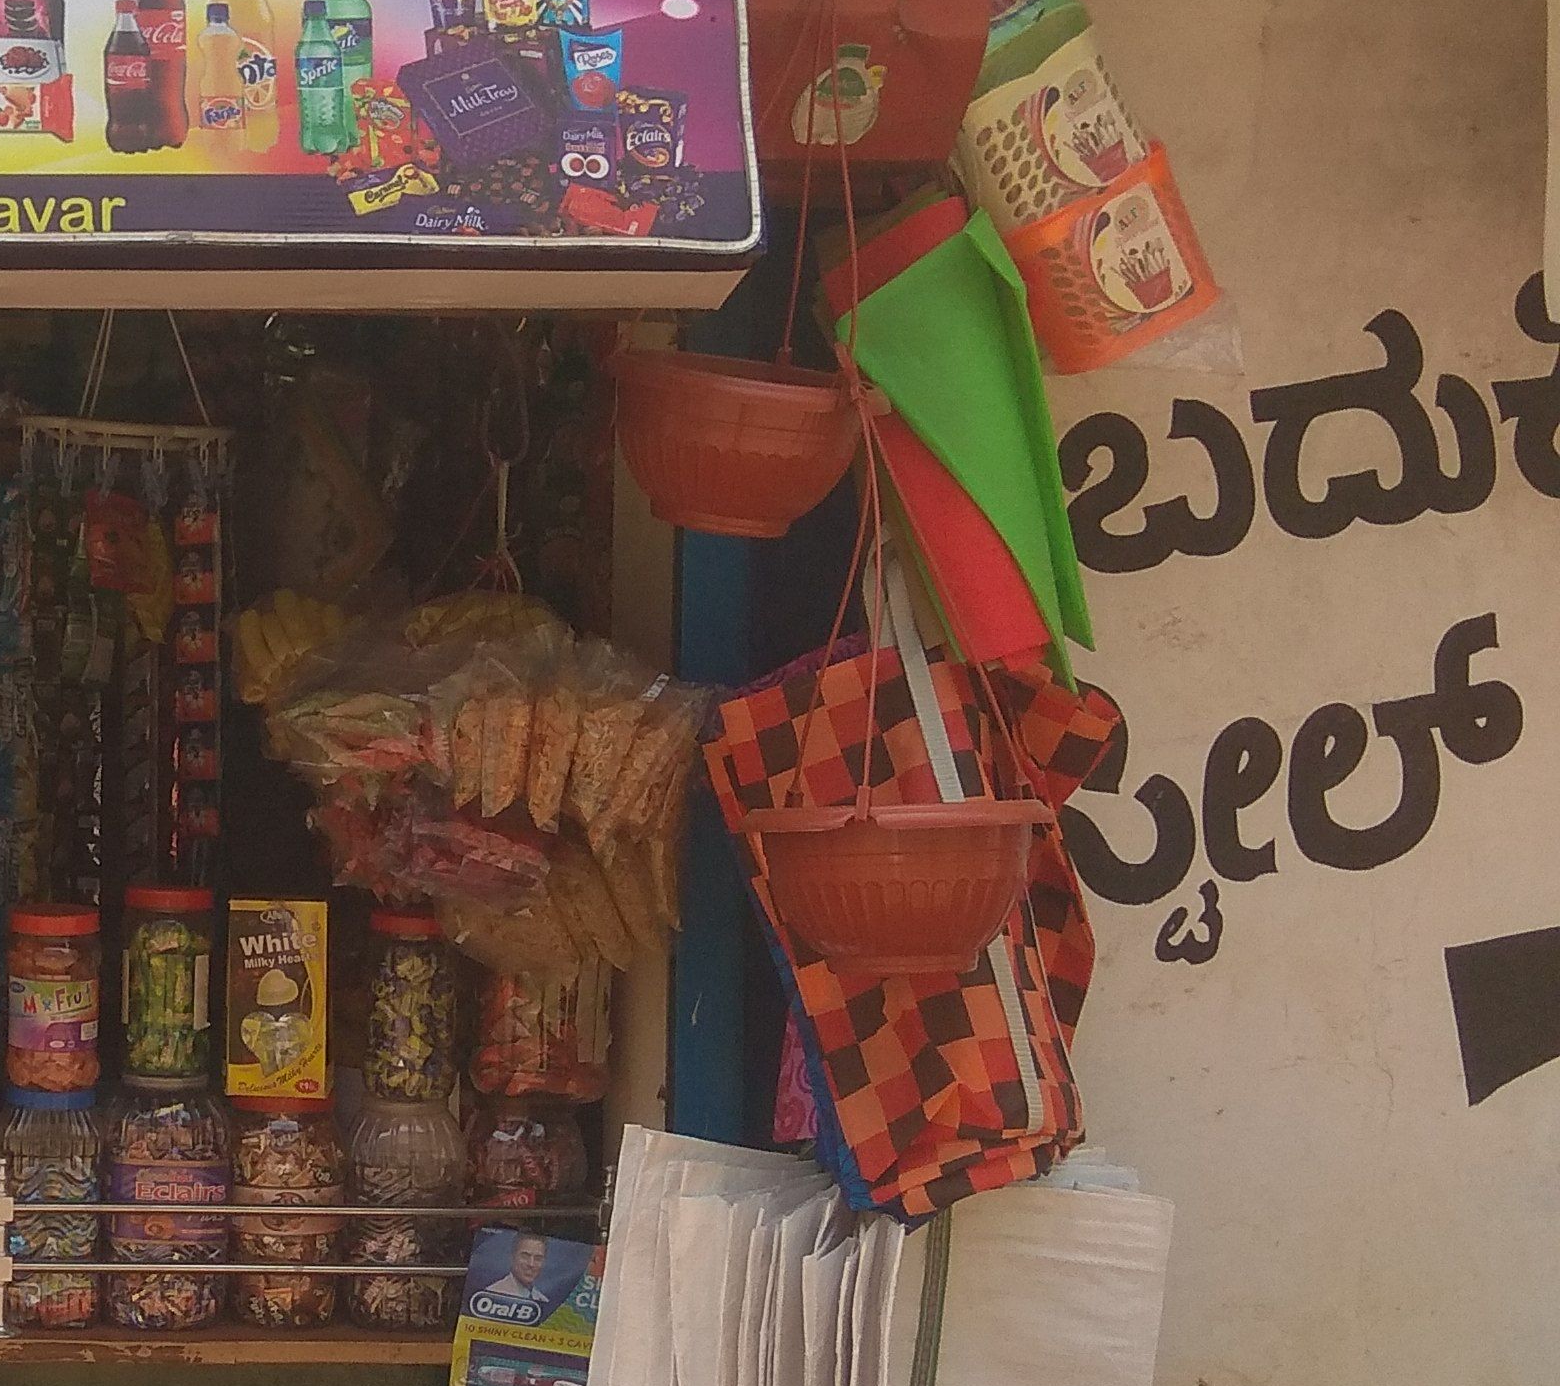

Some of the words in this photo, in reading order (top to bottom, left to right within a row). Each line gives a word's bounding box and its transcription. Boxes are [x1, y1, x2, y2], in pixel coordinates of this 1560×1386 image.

[299, 56, 339, 86] Sprite
[626, 130, 672, 151] Eclairs
[415, 213, 453, 231] Dairy
[454, 212, 486, 230] Milk
[240, 932, 318, 957] White
[244, 957, 275, 970] Milky
[135, 1181, 227, 1203] Eclairs
[476, 1297, 535, 1320] Oral-B
[477, 1326, 509, 1338] SHINY
[511, 1331, 546, 1343] CLEAN
